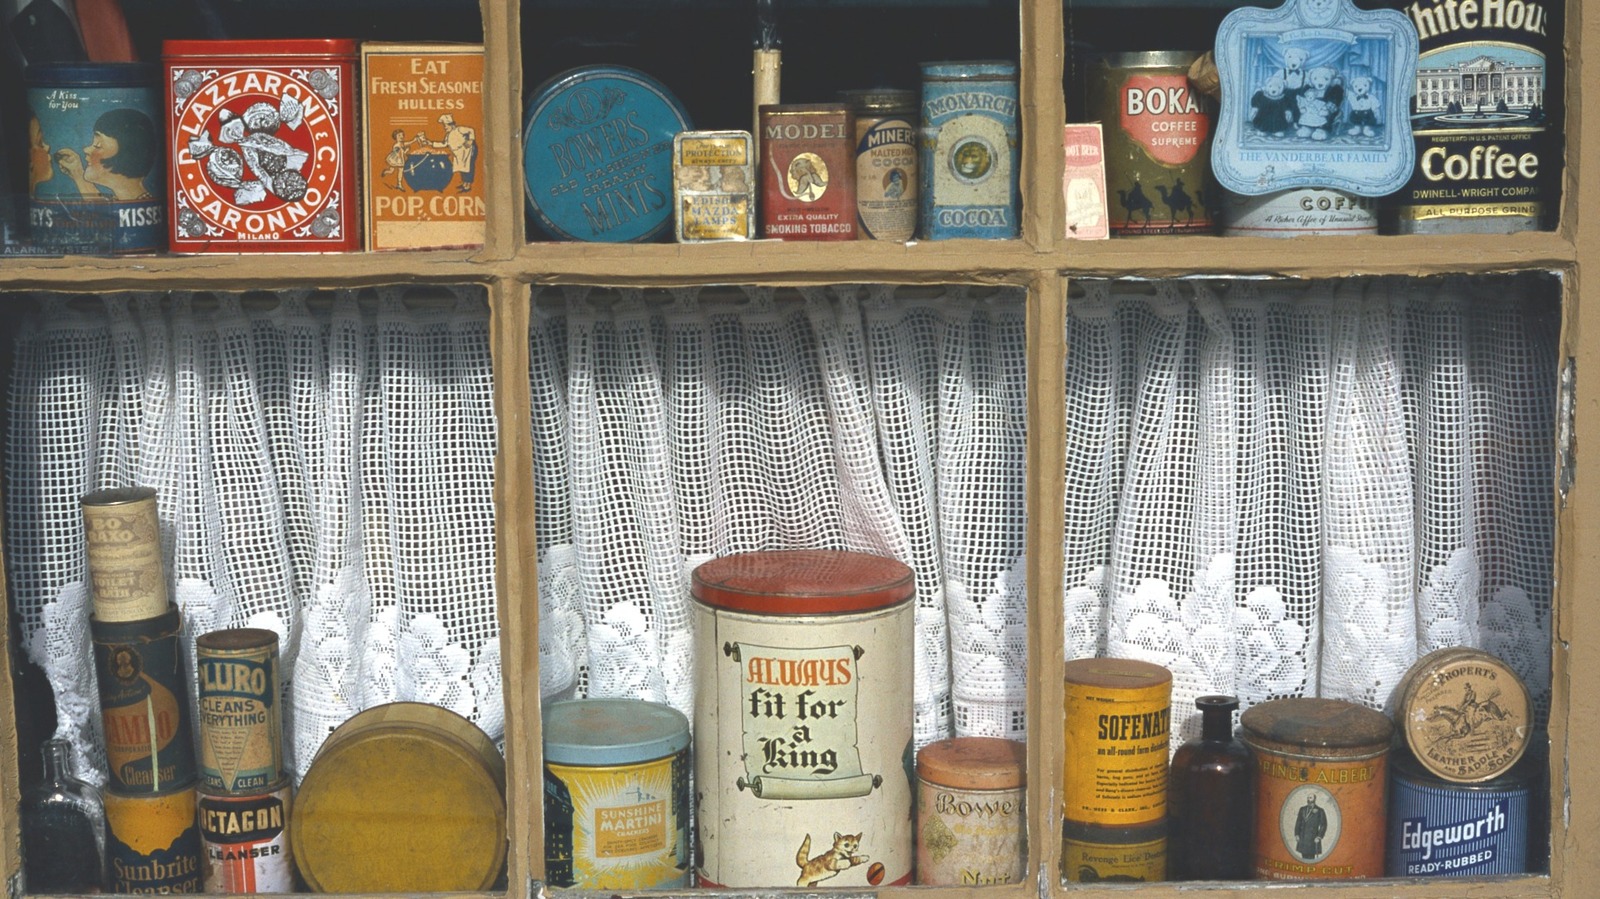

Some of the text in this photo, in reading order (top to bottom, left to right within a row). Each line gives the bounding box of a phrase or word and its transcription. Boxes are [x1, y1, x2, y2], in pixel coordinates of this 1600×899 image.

[411, 58, 450, 75] EAT
[372, 77, 417, 95] FRESH
[47, 91, 77, 99] A Kiss
[1127, 88, 1204, 115] BOKA
[49, 100, 79, 111] for You
[181, 73, 327, 136] LAZZARONI
[398, 99, 465, 110] HULLESS
[927, 92, 1017, 118] MONARCH
[765, 124, 847, 139] MODEL
[1151, 121, 1198, 132] COFFEE
[550, 111, 650, 179] BOWERS
[1151, 137, 1198, 148] SUPREME
[686, 149, 742, 157] PROTECTION
[870, 147, 900, 158] MALTED
[1239, 151, 1390, 163] THE VANDERBEAR FAMILY
[872, 157, 914, 168] COCOA
[1421, 145, 1539, 181] Coffee
[550, 179, 579, 197] OLD
[582, 164, 648, 197] CREAMY
[693, 197, 737, 205] EDISO
[1412, 187, 1500, 199] DWINELL-WRIGHT
[189, 184, 322, 233] SARONNO
[429, 196, 485, 217] CORN
[580, 173, 667, 236] MINTS
[692, 207, 739, 215] MAZDA
[1425, 205, 1536, 216] ALL PURPOSE GRIND
[693, 216, 737, 225] LAMPS
[805, 213, 839, 221] QUALITY
[938, 208, 1007, 228] COCOA
[1264, 215, 1275, 223] A
[1275, 215, 1296, 224] Richer
[1296, 215, 1317, 226] Coffee
[1319, 215, 1328, 225] of
[237, 232, 280, 240] MILANO
[765, 223, 852, 234] SMOKING TOBACCO
[746, 657, 852, 687] ALWAYS
[1437, 666, 1498, 687] PROPERT'S
[202, 699, 255, 714] CLEANS
[747, 687, 847, 720] fit for
[792, 724, 813, 746] a
[757, 737, 839, 775] King
[1107, 745, 1136, 756] all-round
[1137, 745, 1149, 754] farm
[1428, 747, 1476, 766] LEATHER
[1457, 749, 1500, 776] SADDLE
[1488, 747, 1515, 771] SOAP
[237, 776, 265, 788] CLEAN
[1315, 766, 1375, 783] ALBERT
[600, 803, 662, 819] SUNSHINE
[600, 814, 662, 832] MARTINI
[616, 828, 649, 837] CRACKERS
[1402, 804, 1506, 860] Edgeworth
[1082, 852, 1119, 865] Revenge
[1122, 851, 1142, 863] Lice
[1408, 850, 1493, 875] READY-RUBBED
[113, 855, 197, 882] Sunbrite
[1322, 864, 1353, 875] CUT
